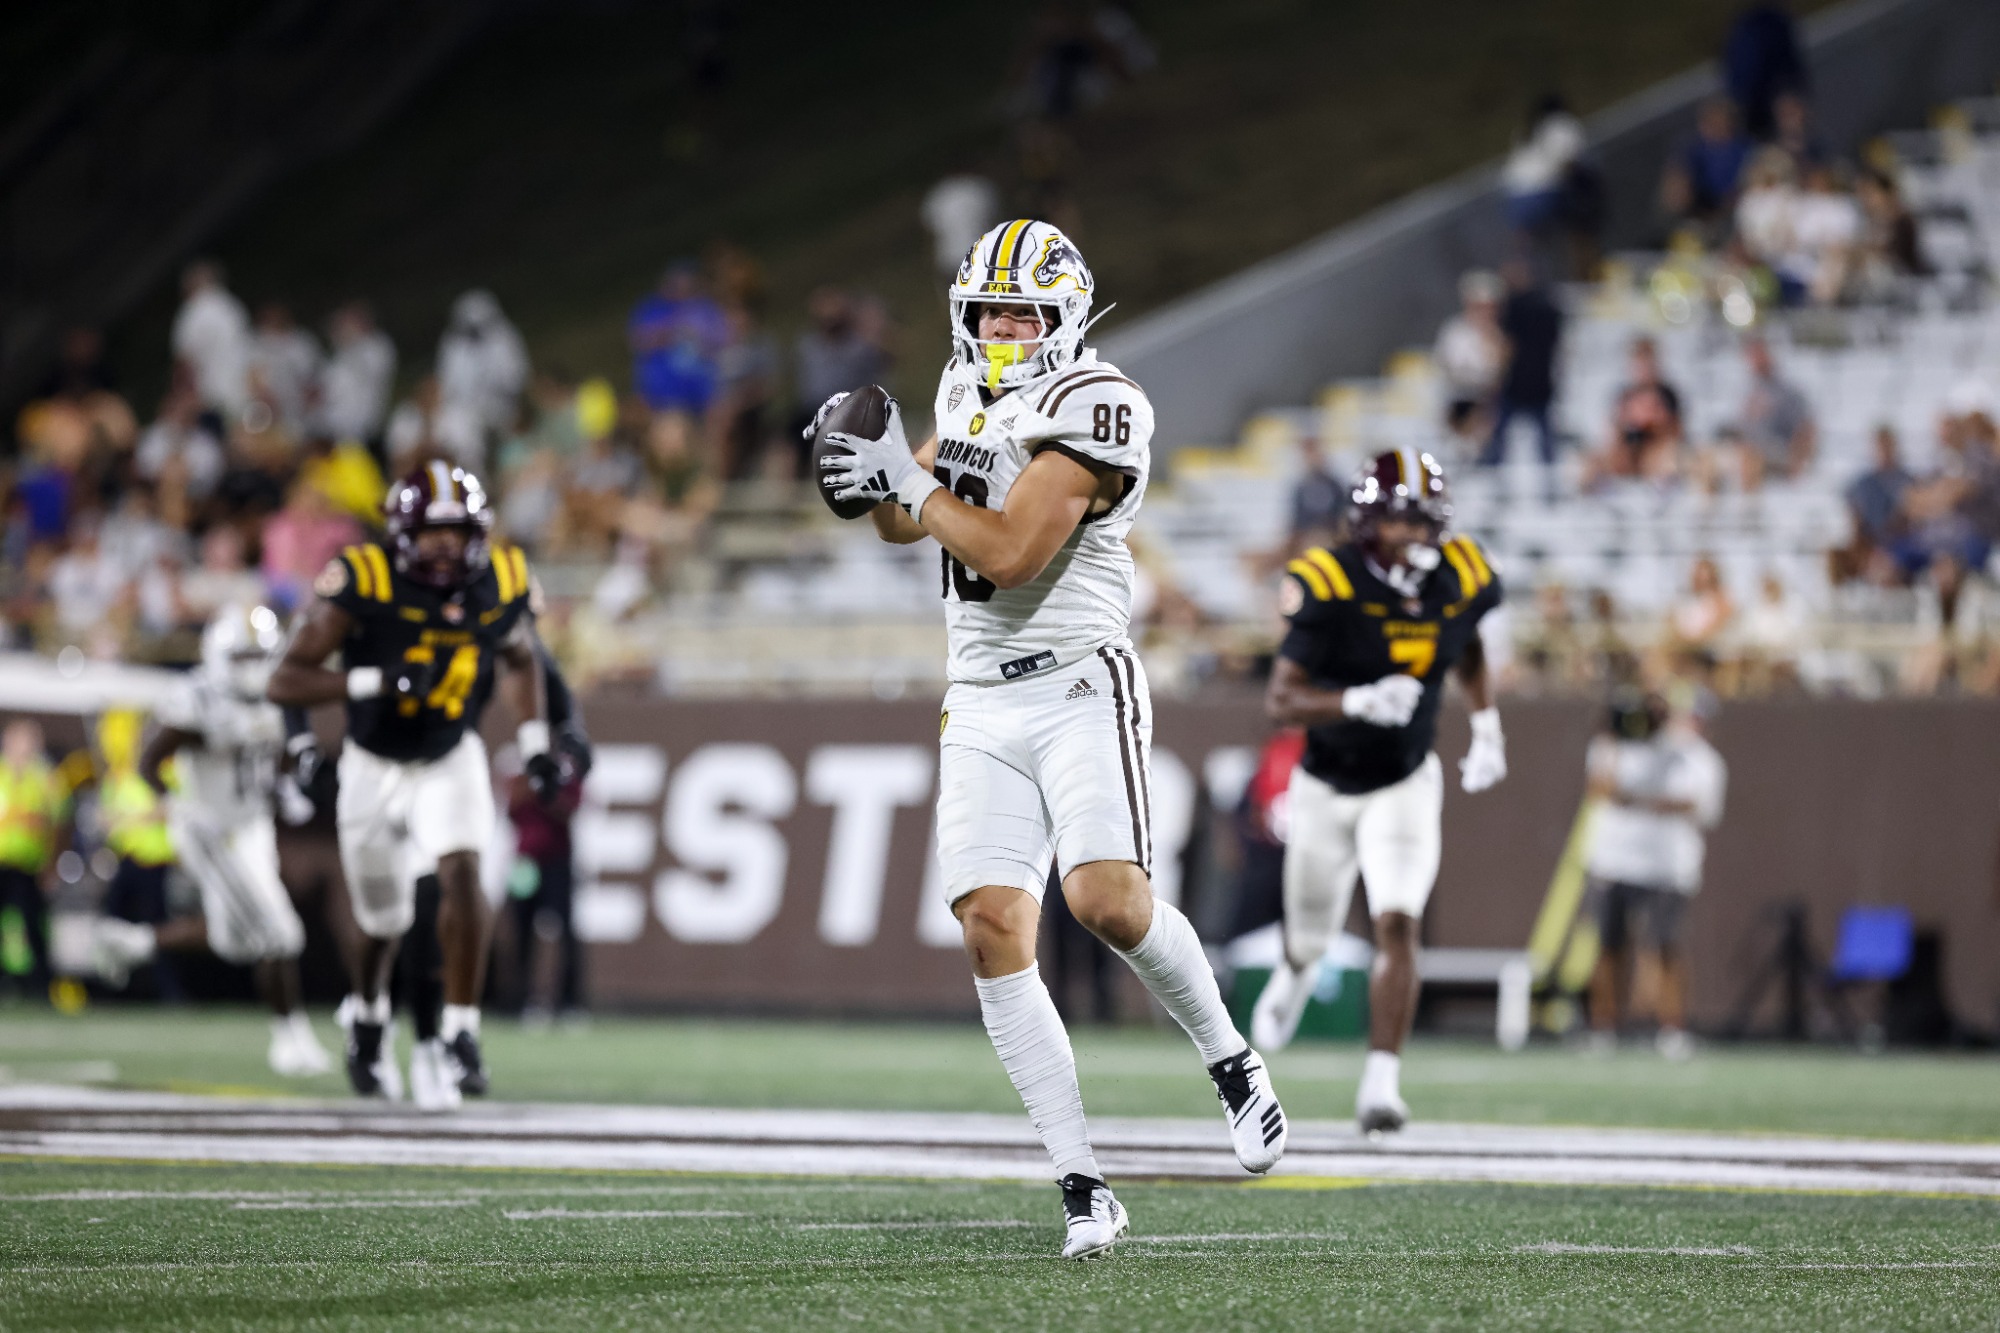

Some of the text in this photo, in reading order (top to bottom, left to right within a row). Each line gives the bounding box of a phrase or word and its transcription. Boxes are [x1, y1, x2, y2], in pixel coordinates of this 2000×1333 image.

[988, 283, 1012, 294] EAT
[970, 416, 984, 433] W
[1093, 403, 1132, 446] 86
[937, 438, 999, 473] BRONCOS
[1389, 638, 1437, 679] 7
[1065, 687, 1098, 701] adidas
